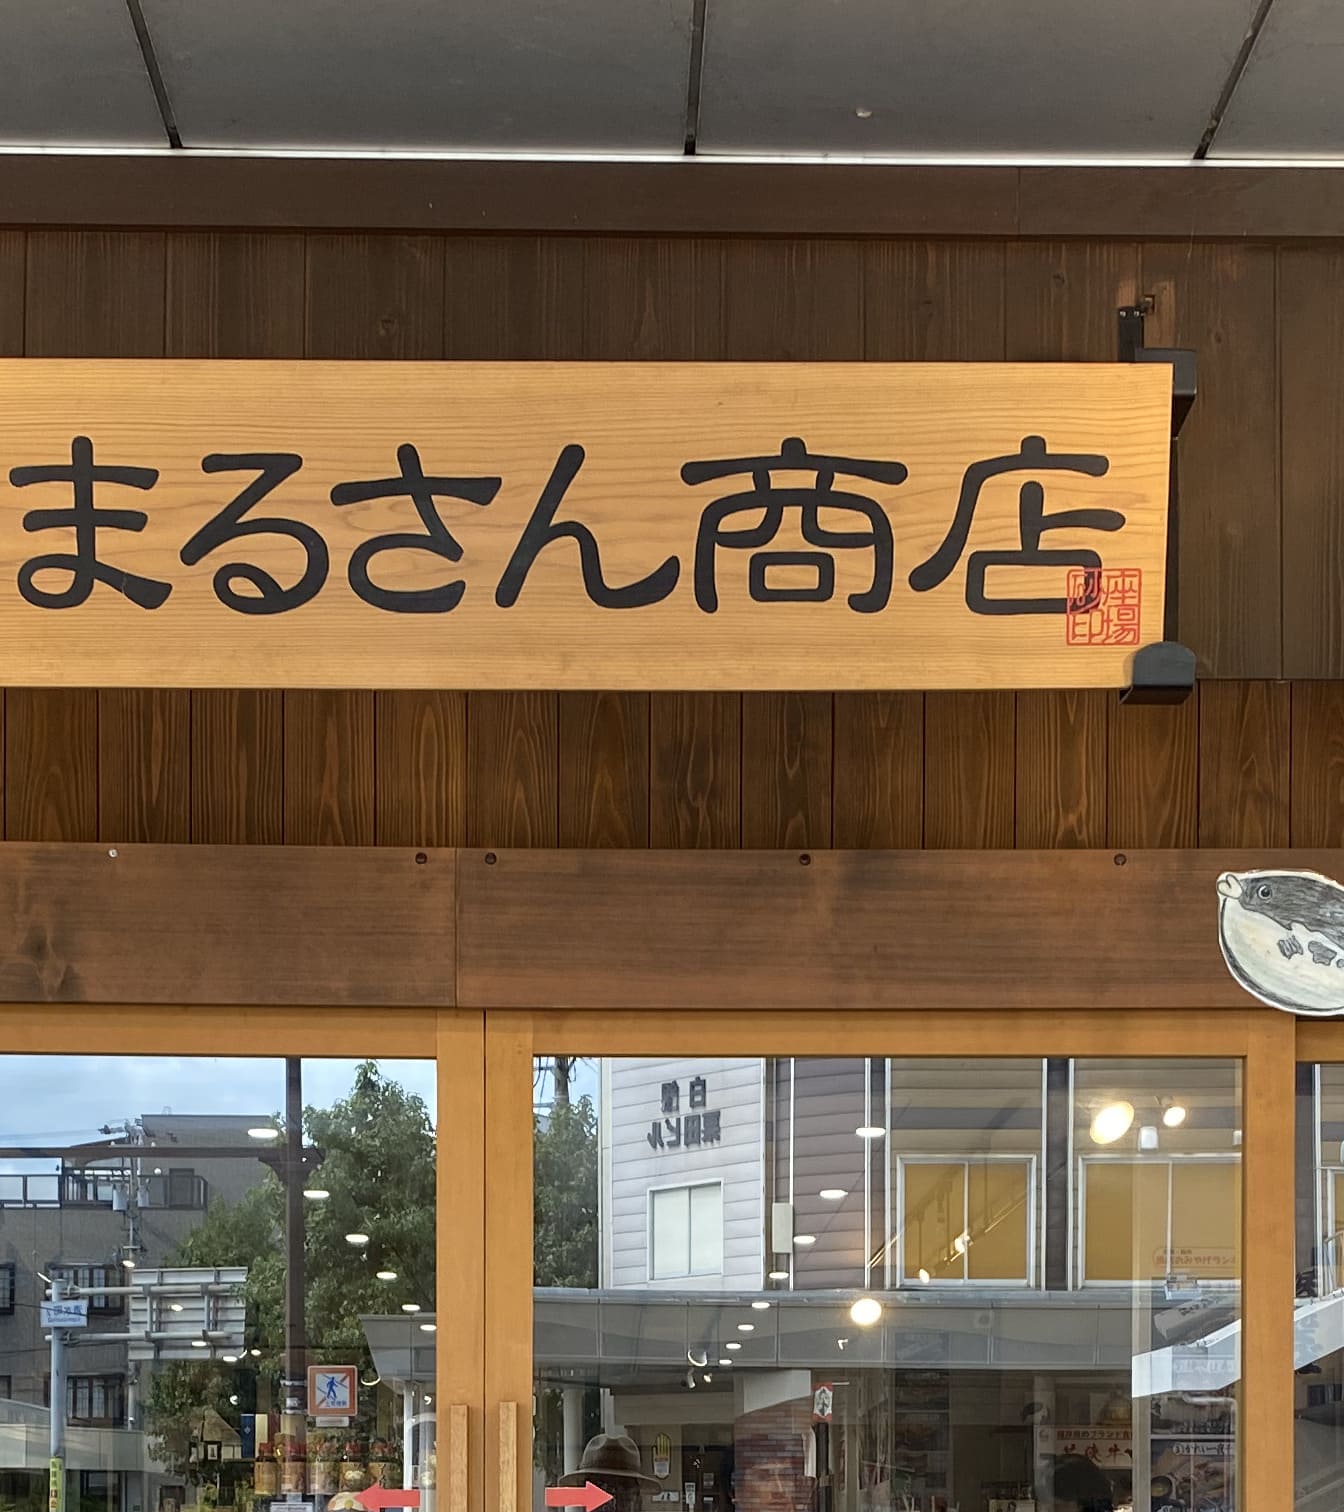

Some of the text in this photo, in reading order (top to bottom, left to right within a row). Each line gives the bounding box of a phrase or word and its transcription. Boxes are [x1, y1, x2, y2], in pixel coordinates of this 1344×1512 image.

[8, 435, 1127, 616] まるさん商店
